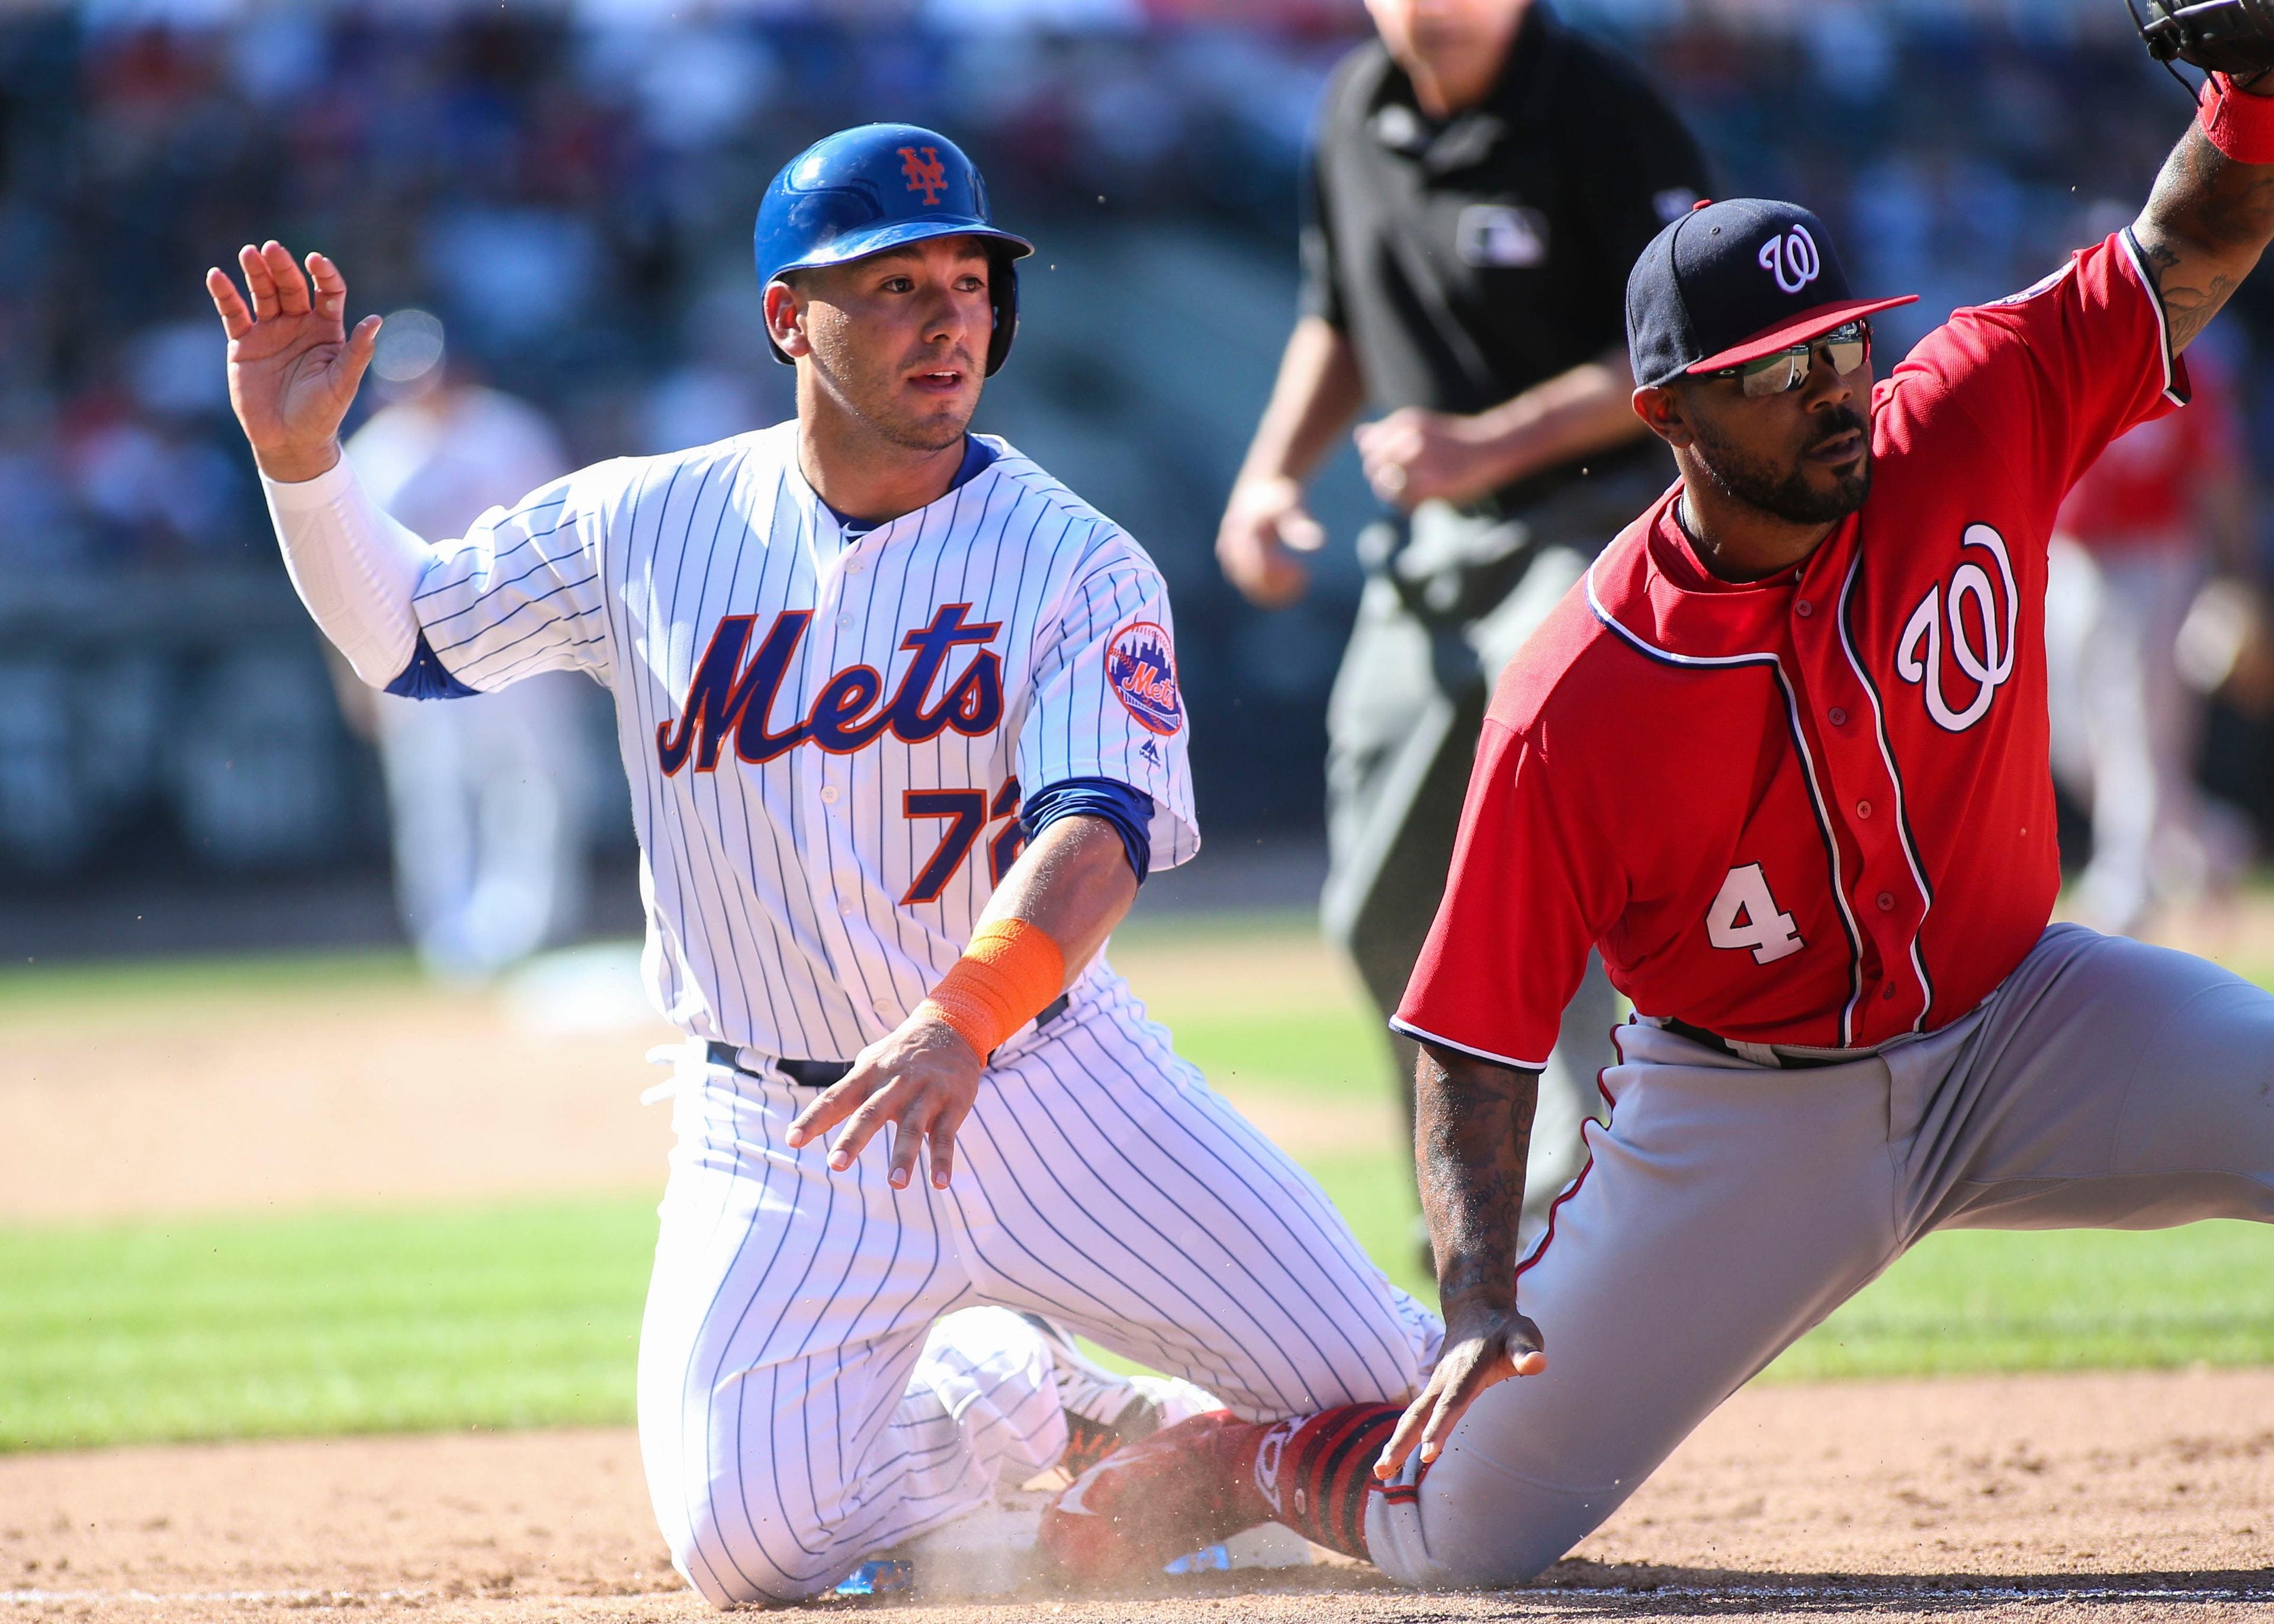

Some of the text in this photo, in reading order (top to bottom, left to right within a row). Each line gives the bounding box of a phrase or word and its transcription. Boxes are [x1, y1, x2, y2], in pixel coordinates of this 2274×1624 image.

[1758, 223, 1820, 293] W
[1897, 521, 2019, 734] W
[657, 602, 1004, 777] Mets
[1121, 660, 1175, 710] Mets
[1705, 860, 1806, 966] 4
